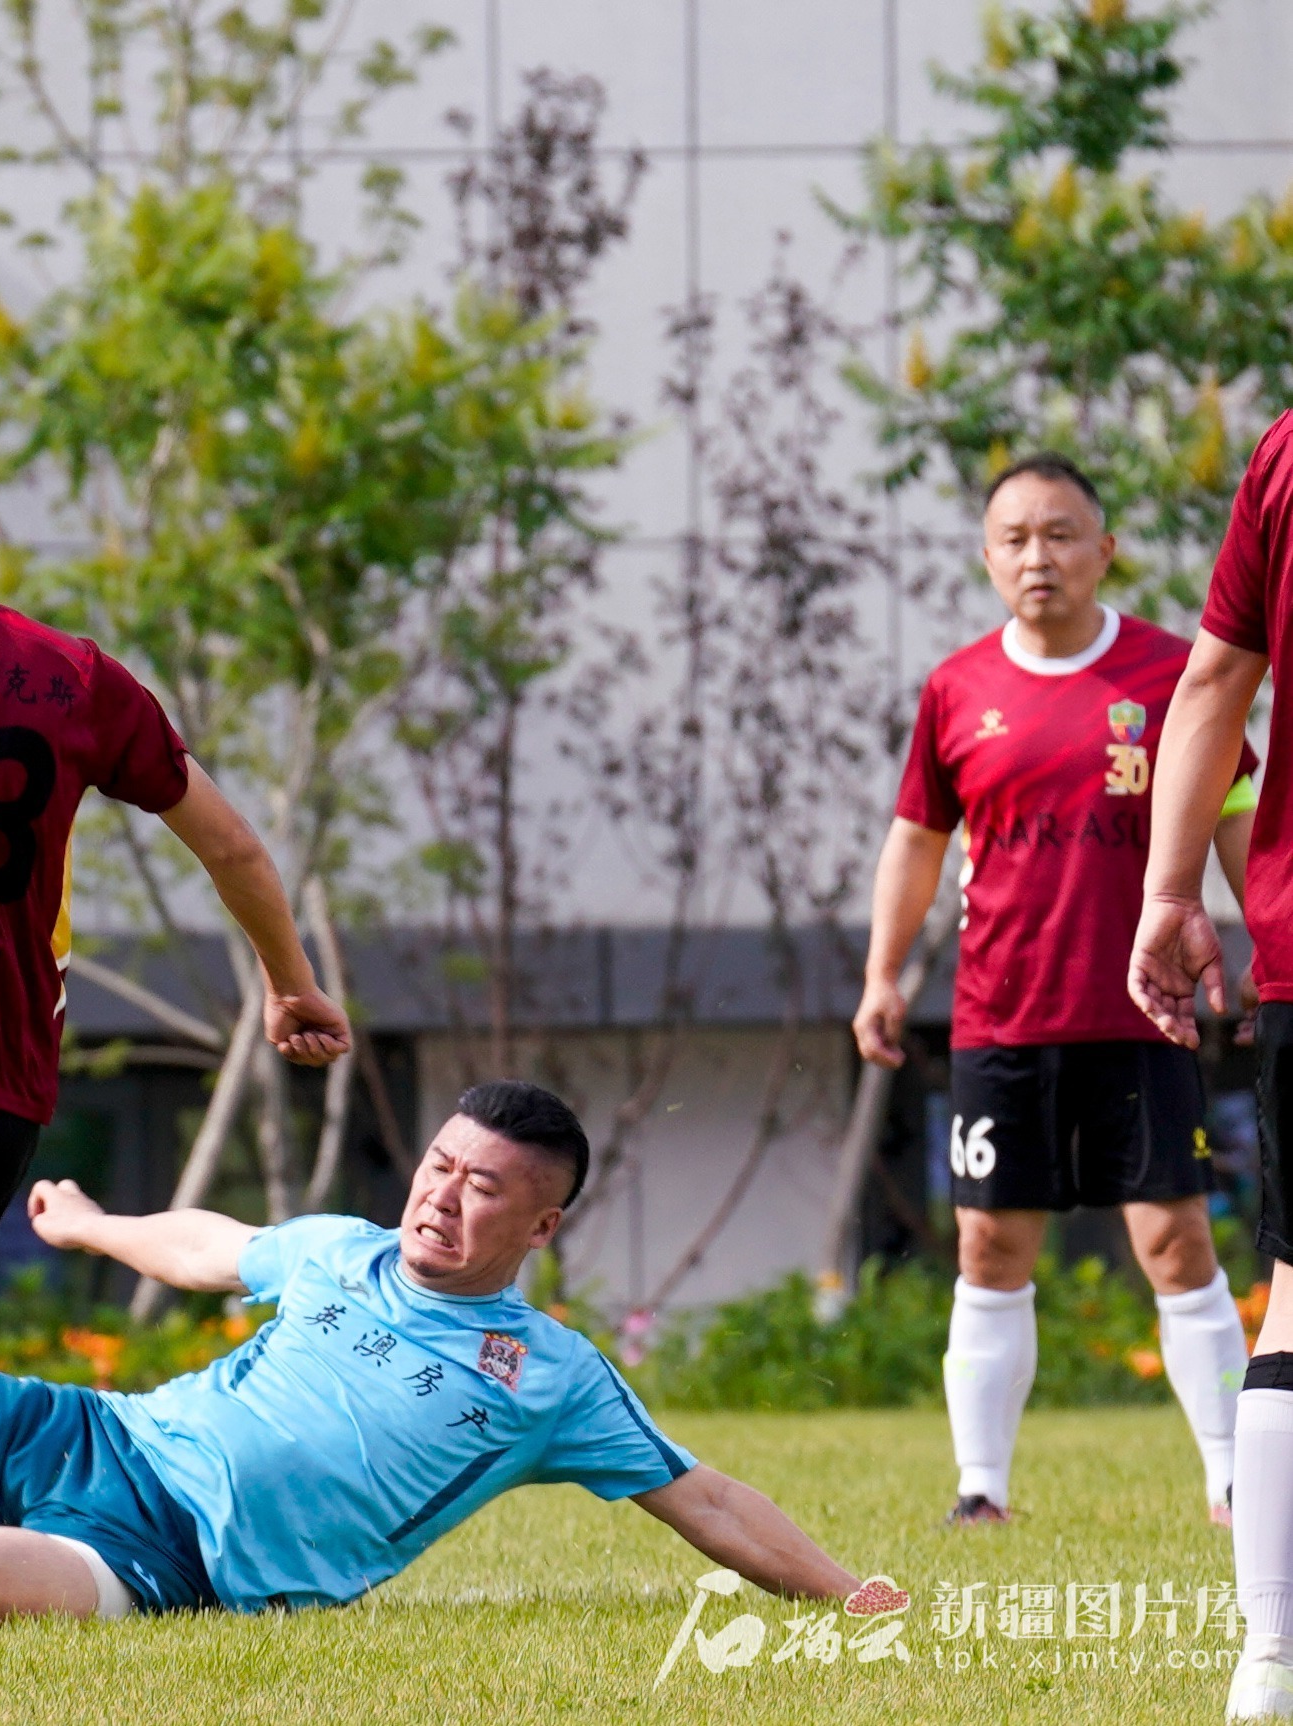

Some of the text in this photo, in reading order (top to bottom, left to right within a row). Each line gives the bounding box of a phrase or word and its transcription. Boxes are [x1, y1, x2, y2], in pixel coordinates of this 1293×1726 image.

[1105, 743, 1149, 795] 30
[950, 1114, 996, 1180] 66
[304, 1303, 490, 1433] 英澳房产
